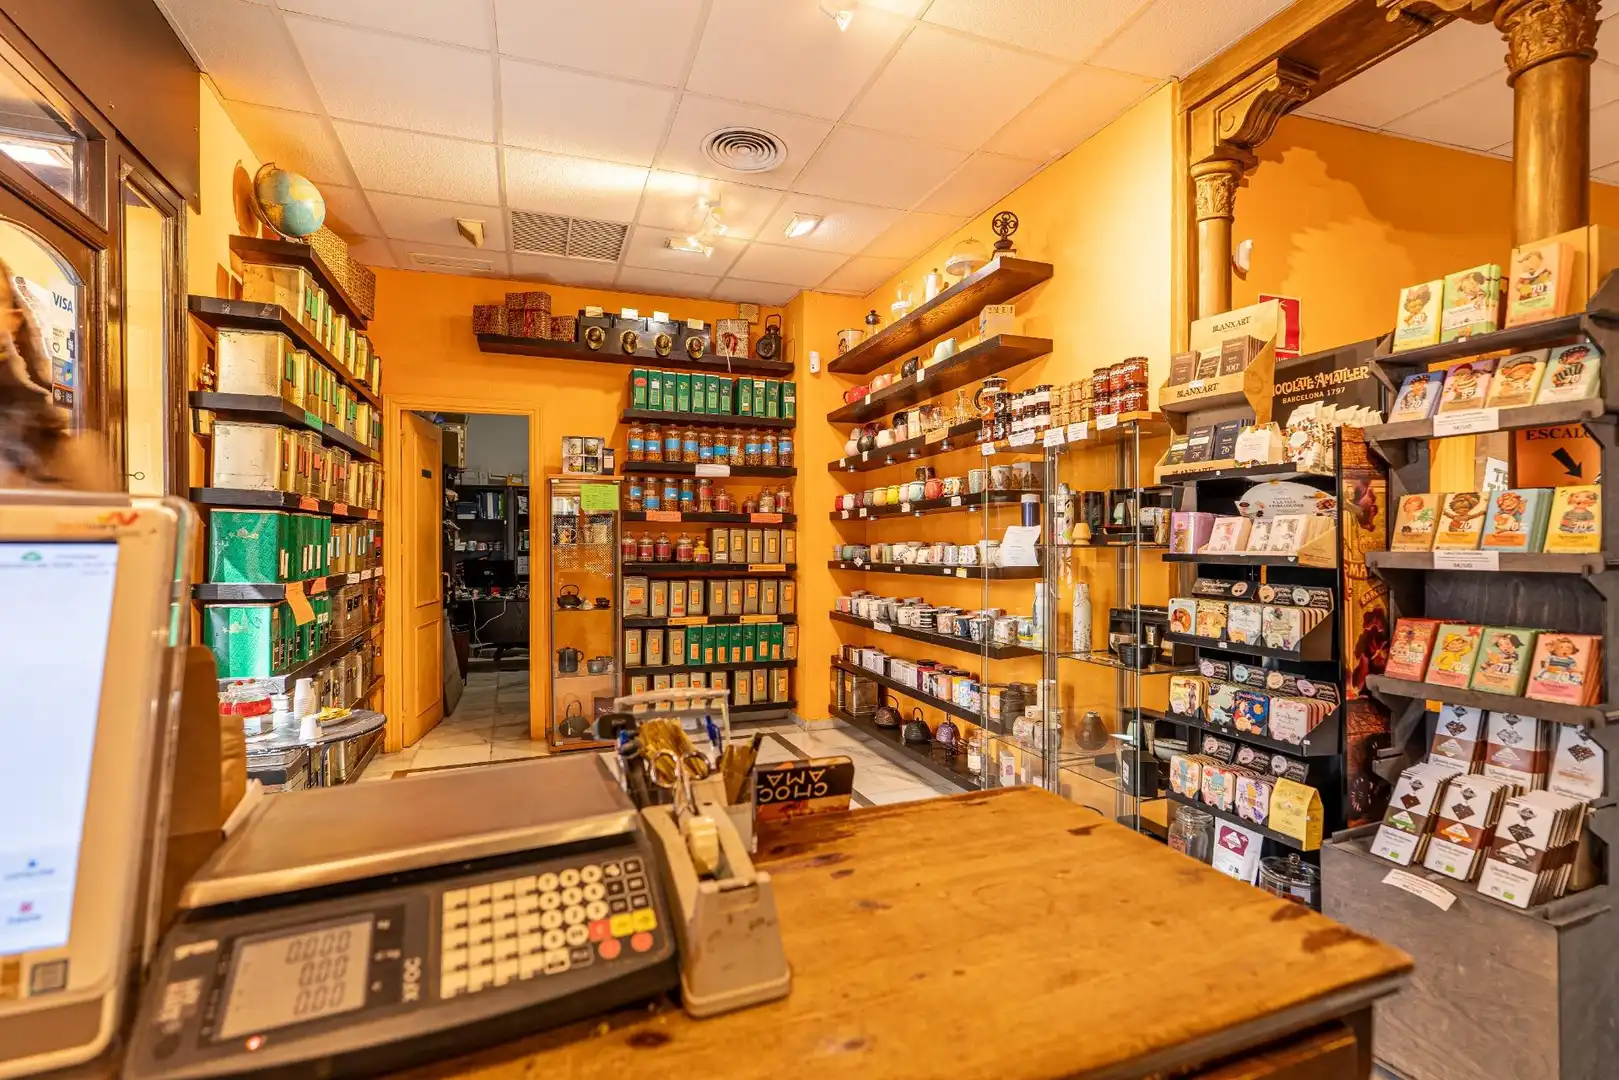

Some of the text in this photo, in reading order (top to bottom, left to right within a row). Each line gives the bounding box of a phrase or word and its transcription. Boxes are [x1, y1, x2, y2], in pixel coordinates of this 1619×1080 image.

[52, 292, 74, 314] VISA
[1211, 316, 1251, 333] BLANXART
[1176, 383, 1219, 398] BLANXART
[1282, 387, 1346, 404] BARCELONA 1797
